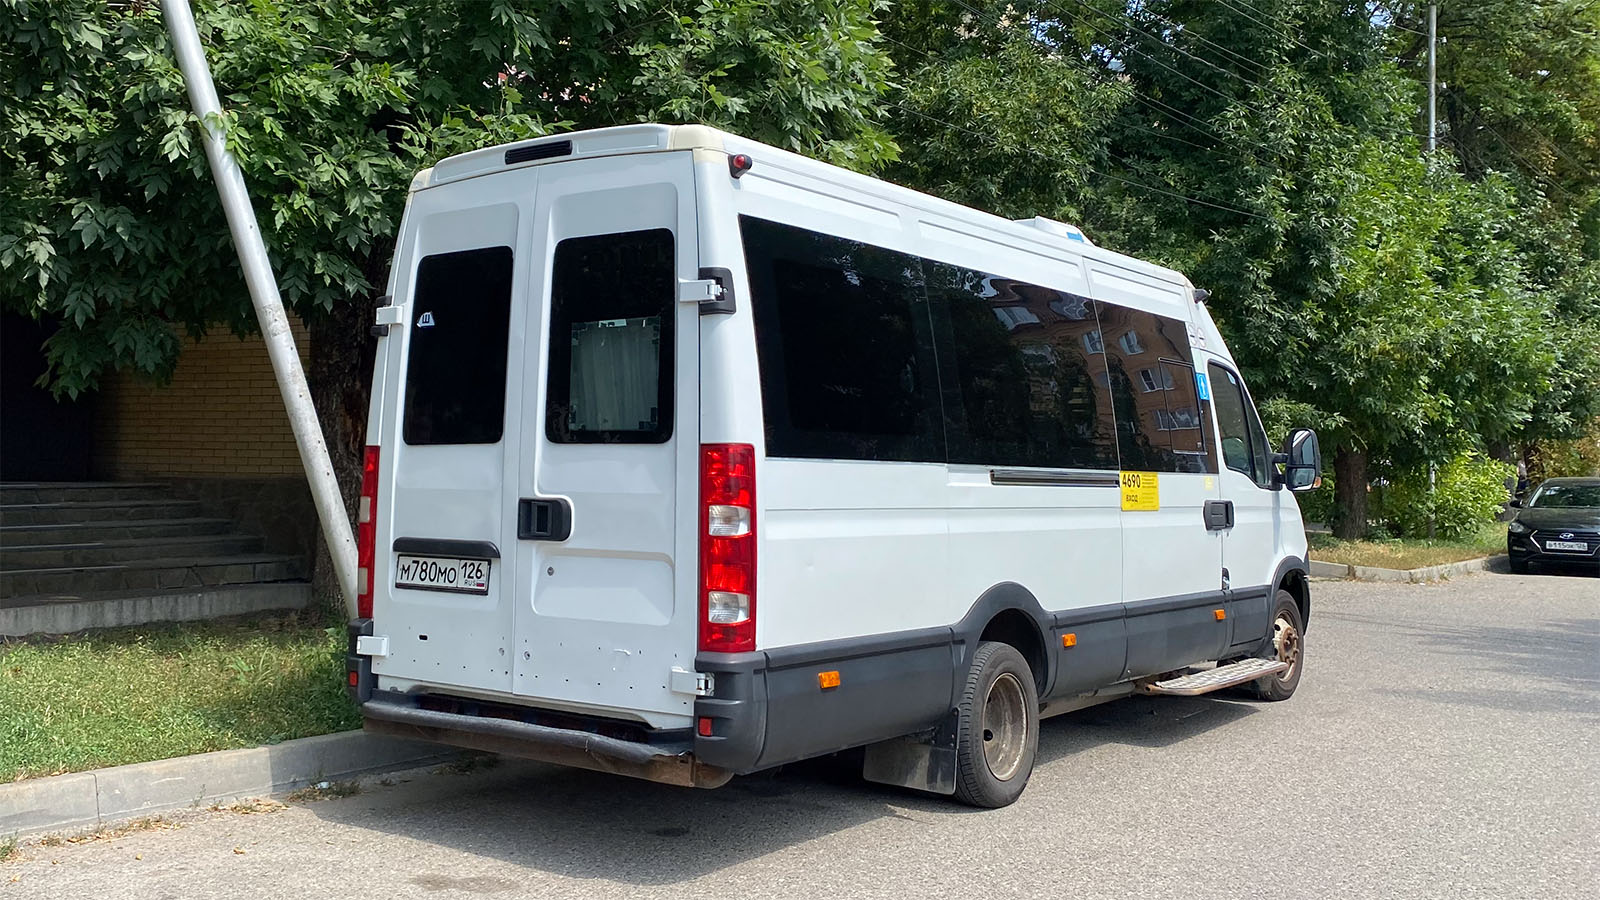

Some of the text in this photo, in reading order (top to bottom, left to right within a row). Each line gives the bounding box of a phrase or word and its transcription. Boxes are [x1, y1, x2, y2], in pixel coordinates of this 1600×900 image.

[1122, 473, 1141, 489] 4690
[400, 560, 482, 583] М780МО 126
[464, 579, 477, 587] RUS
